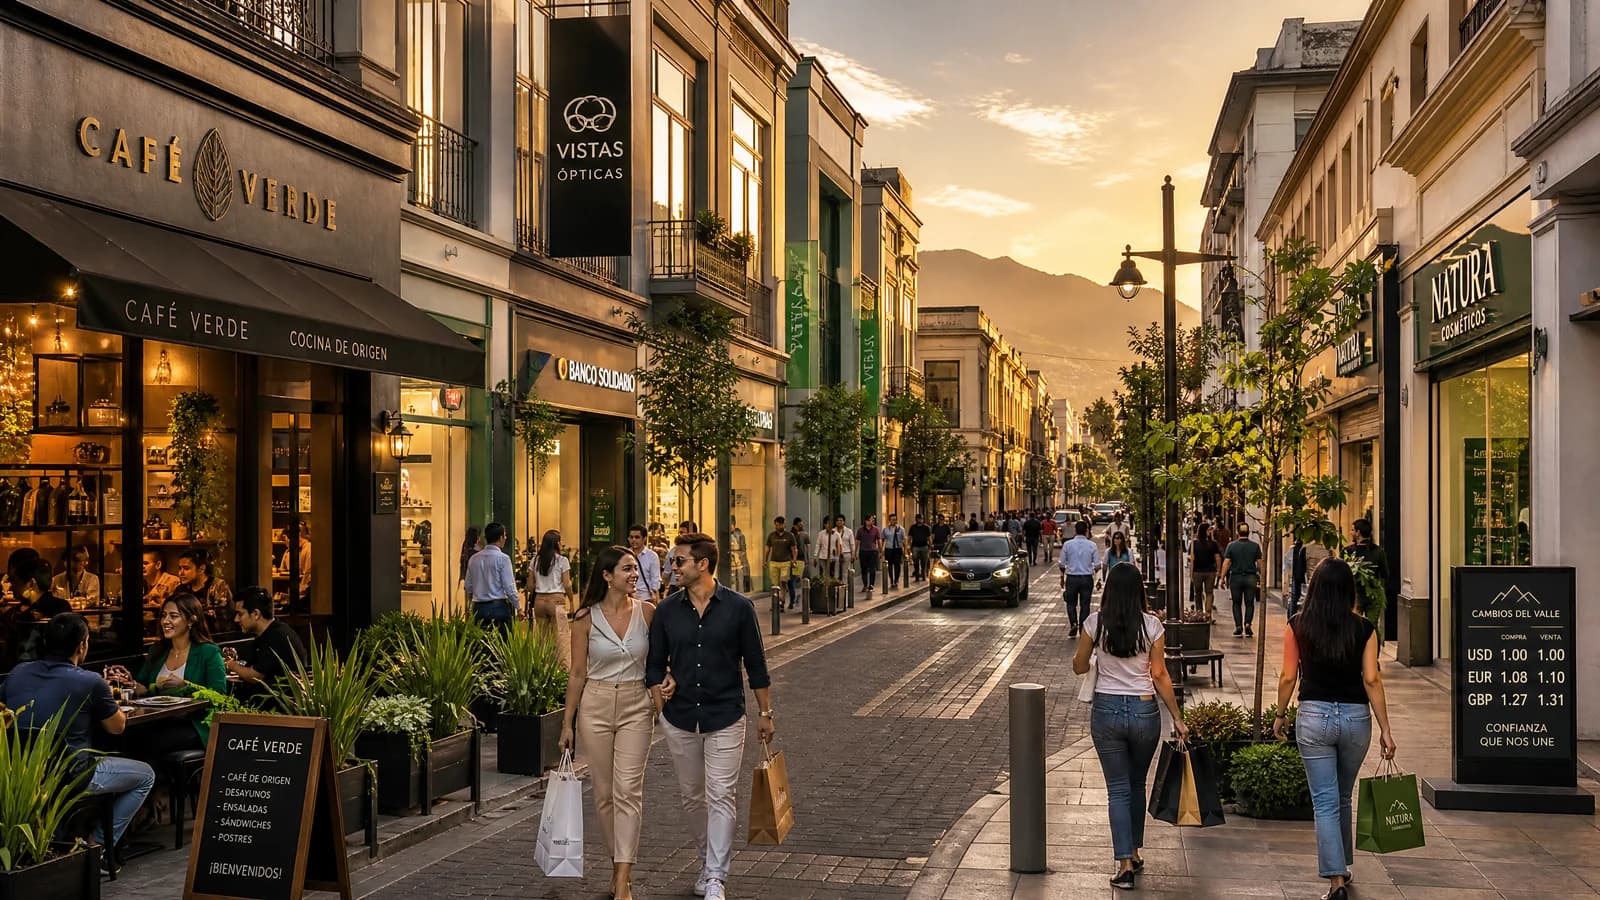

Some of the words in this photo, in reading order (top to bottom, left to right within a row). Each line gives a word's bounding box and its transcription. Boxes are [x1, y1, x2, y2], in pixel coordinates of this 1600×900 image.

[556, 141, 624, 159] VISTAS
[78, 116, 183, 184] CAFÉ
[239, 169, 337, 231] VERDE
[557, 167, 623, 181] ÓPTICAS
[1432, 240, 1498, 323] NATURA
[125, 299, 177, 328] CAFÉ
[191, 312, 248, 340] VERDE
[1441, 307, 1486, 341] COSMÉTICOS
[289, 330, 331, 353] COCINA
[335, 340, 349, 355] DE
[352, 342, 387, 361] ORIGEN
[569, 360, 597, 385] BANCO
[599, 367, 636, 393] SOLIDARIO
[1472, 610, 1513, 618] CAMBIOS
[1515, 610, 1531, 618] DEL
[1534, 610, 1561, 618] VALLE
[1467, 648, 1493, 661] USD
[1500, 648, 1528, 661] 1.00
[1537, 648, 1565, 661] 1.00
[1467, 671, 1493, 684] EUR
[1500, 671, 1528, 684] 1.08
[1537, 671, 1565, 684] 1.10
[1467, 693, 1493, 706] GBP
[1500, 693, 1528, 706] 1.27
[1537, 693, 1565, 706] 1.31
[1486, 723, 1548, 733] CONFIANZA
[228, 737, 259, 751] CAFÉ
[263, 741, 303, 754] VERDE
[1480, 737, 1503, 747] QUE
[1506, 737, 1529, 747] NOS
[1532, 737, 1555, 747] UNE
[228, 772, 247, 782] CAFÉ
[249, 774, 259, 783] DE
[262, 775, 291, 785] ORIGEN
[225, 788, 271, 799] DESAYUNOS
[223, 803, 268, 814] ENSALADAS
[220, 817, 272, 830] SÁNDWICHES
[1385, 813, 1414, 826] NATURA
[218, 833, 253, 844] POSTRES
[209, 862, 282, 880] ¡BIENVENIDOS!
